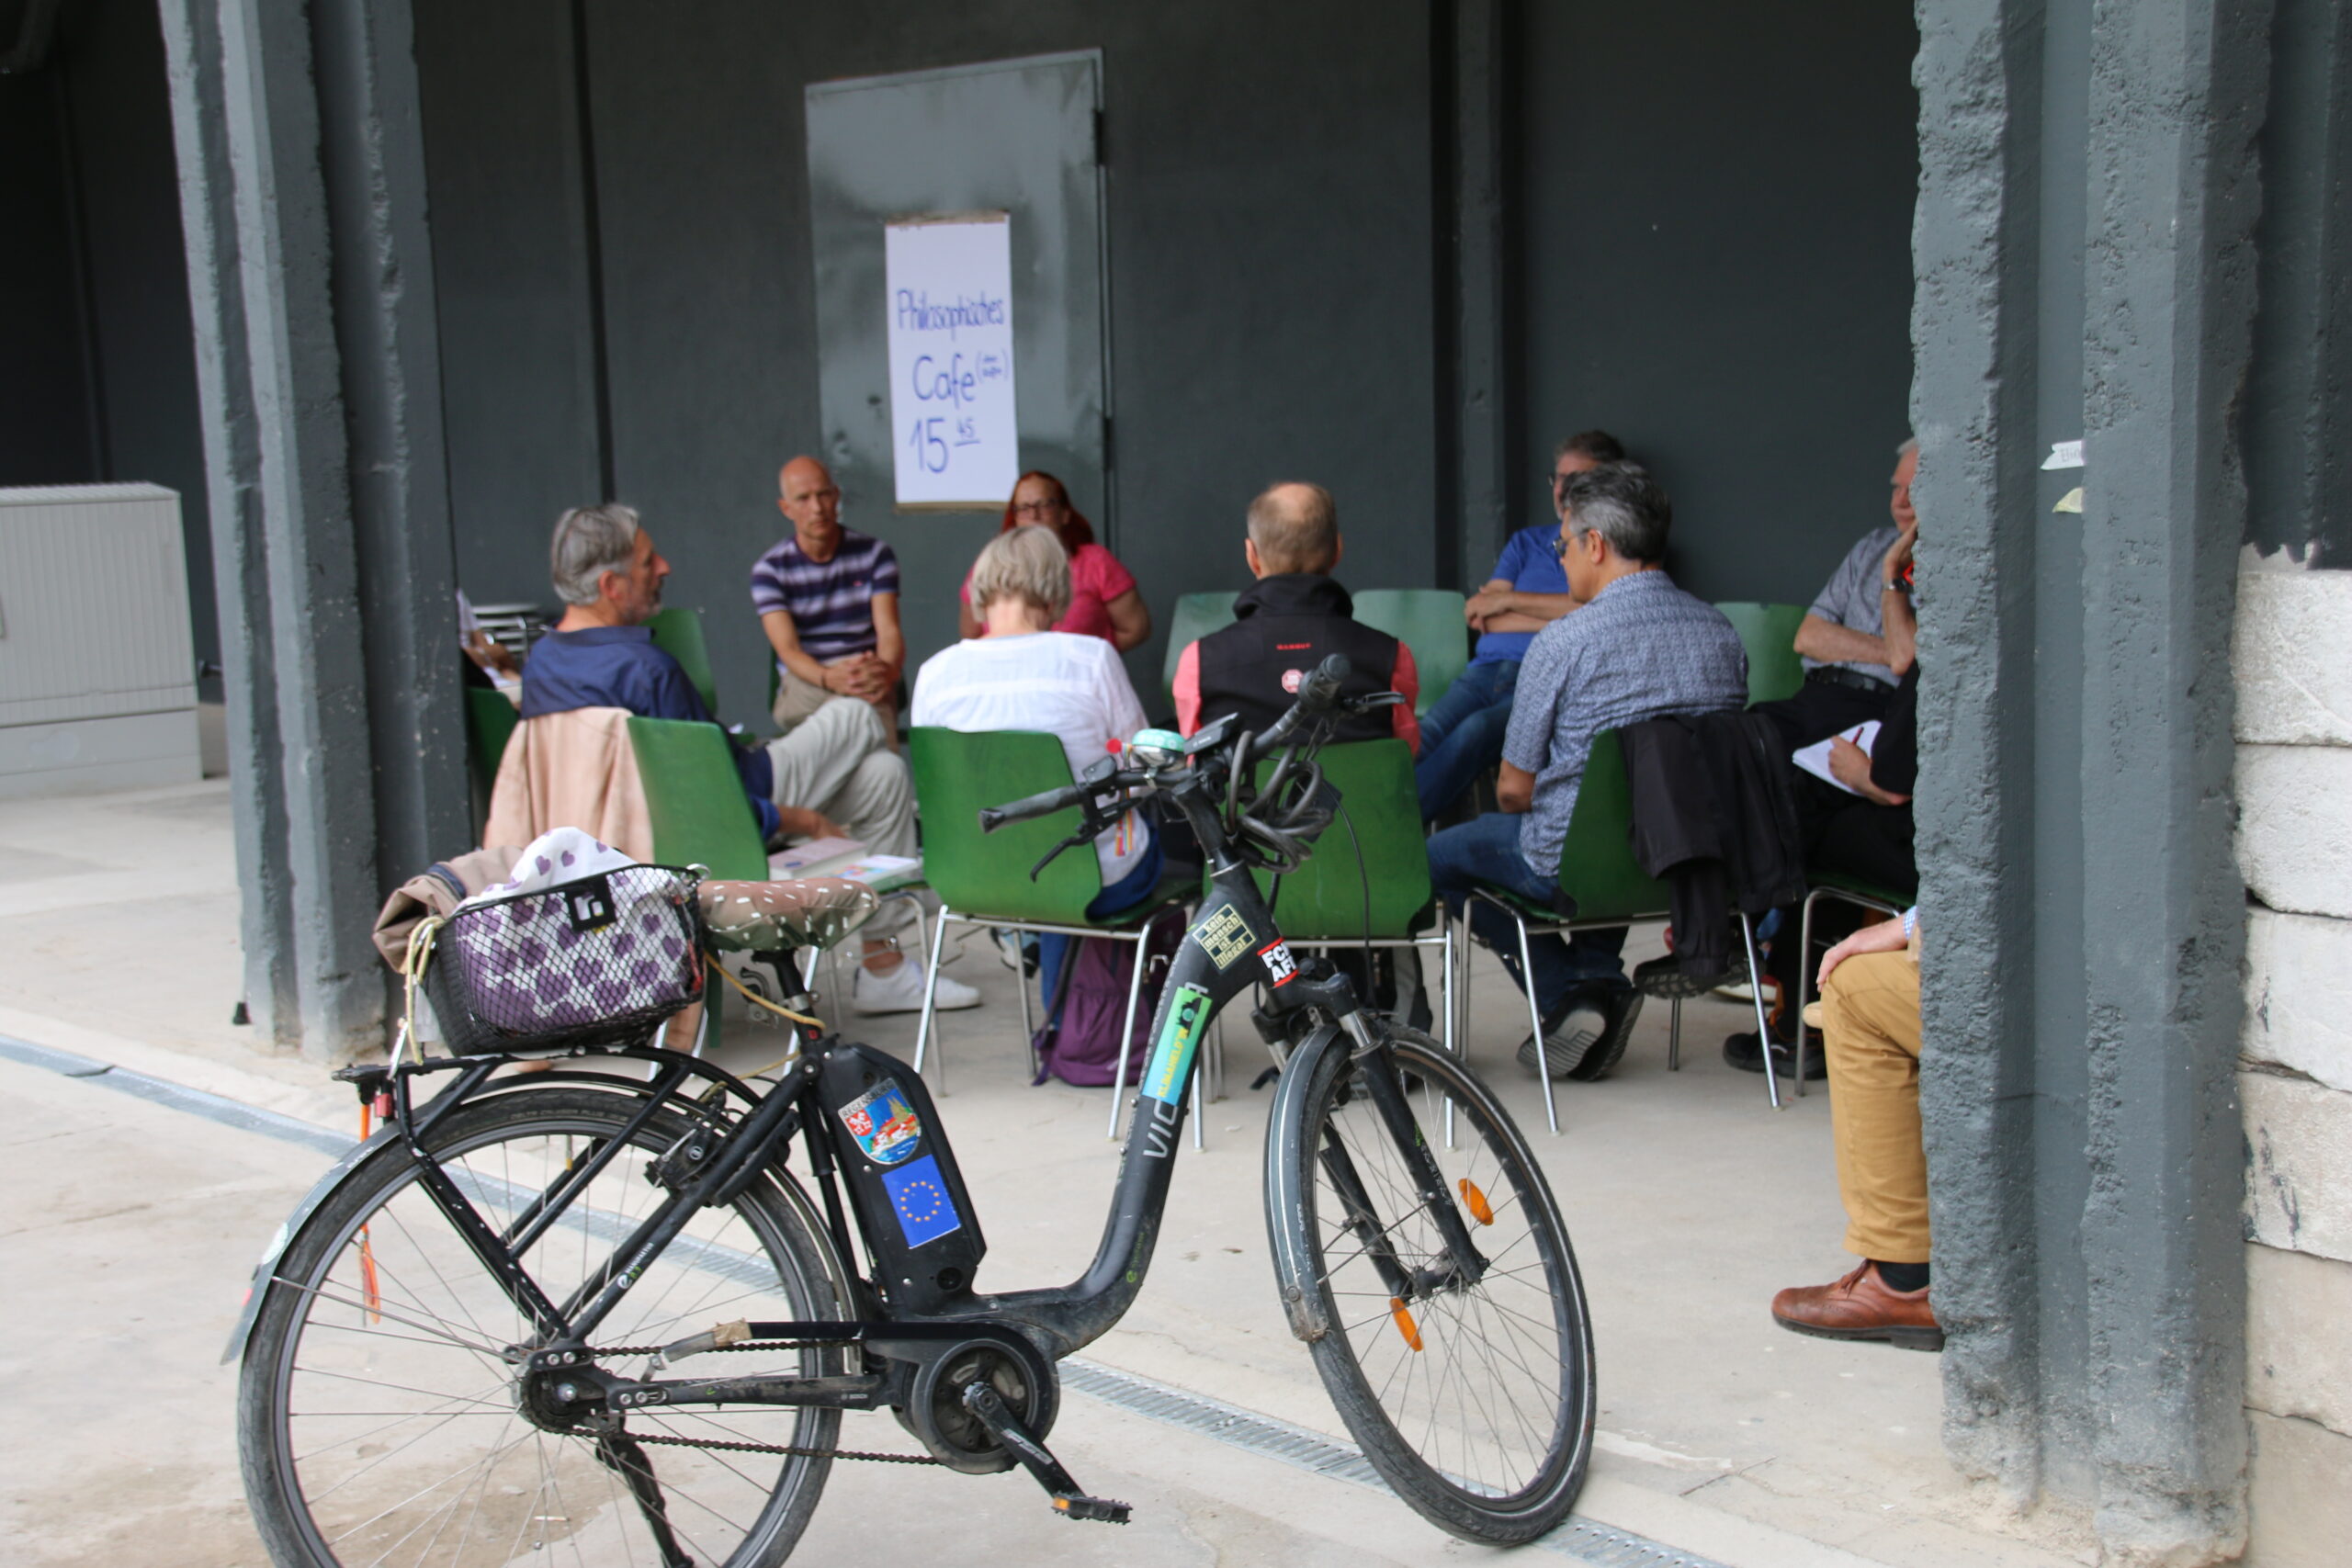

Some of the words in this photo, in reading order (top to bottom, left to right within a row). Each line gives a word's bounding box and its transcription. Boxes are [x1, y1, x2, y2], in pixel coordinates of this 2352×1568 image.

[1203, 913, 1226, 931] kein
[1204, 914, 1240, 948] mensch
[1216, 938, 1247, 967] illegal
[1217, 937, 1232, 951] ist
